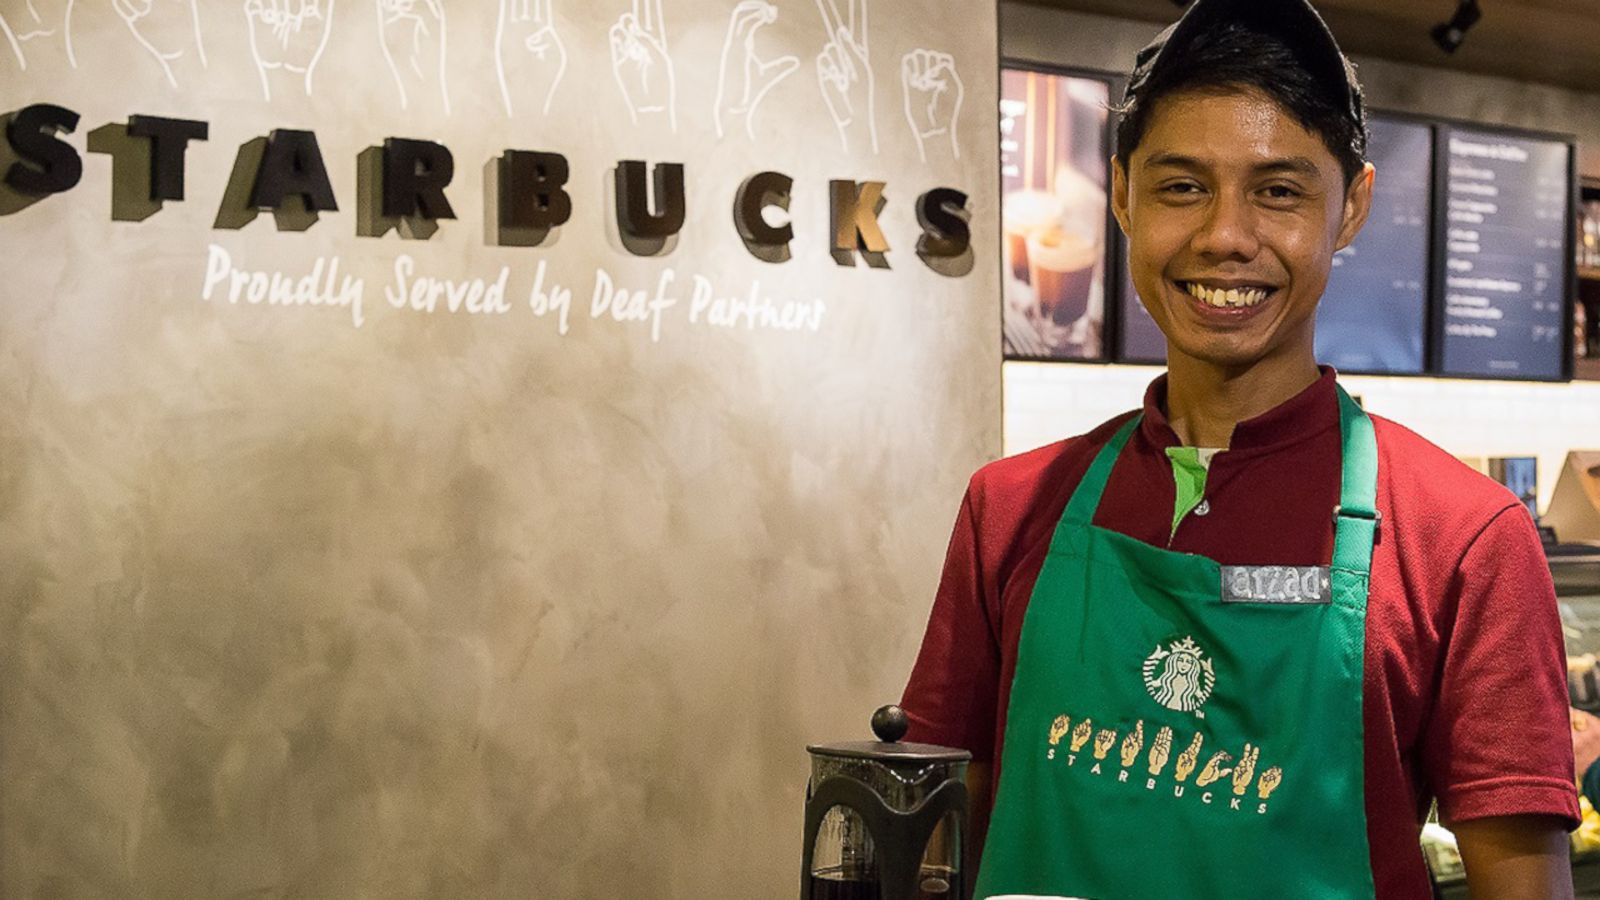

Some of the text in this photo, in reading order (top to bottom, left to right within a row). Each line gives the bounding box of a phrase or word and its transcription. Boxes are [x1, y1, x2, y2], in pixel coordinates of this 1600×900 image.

[2, 103, 973, 272] STARBUCKS
[203, 245, 825, 342] Proudly Served by Deaf Partners
[1046, 747, 1268, 815] STARBUCKS
